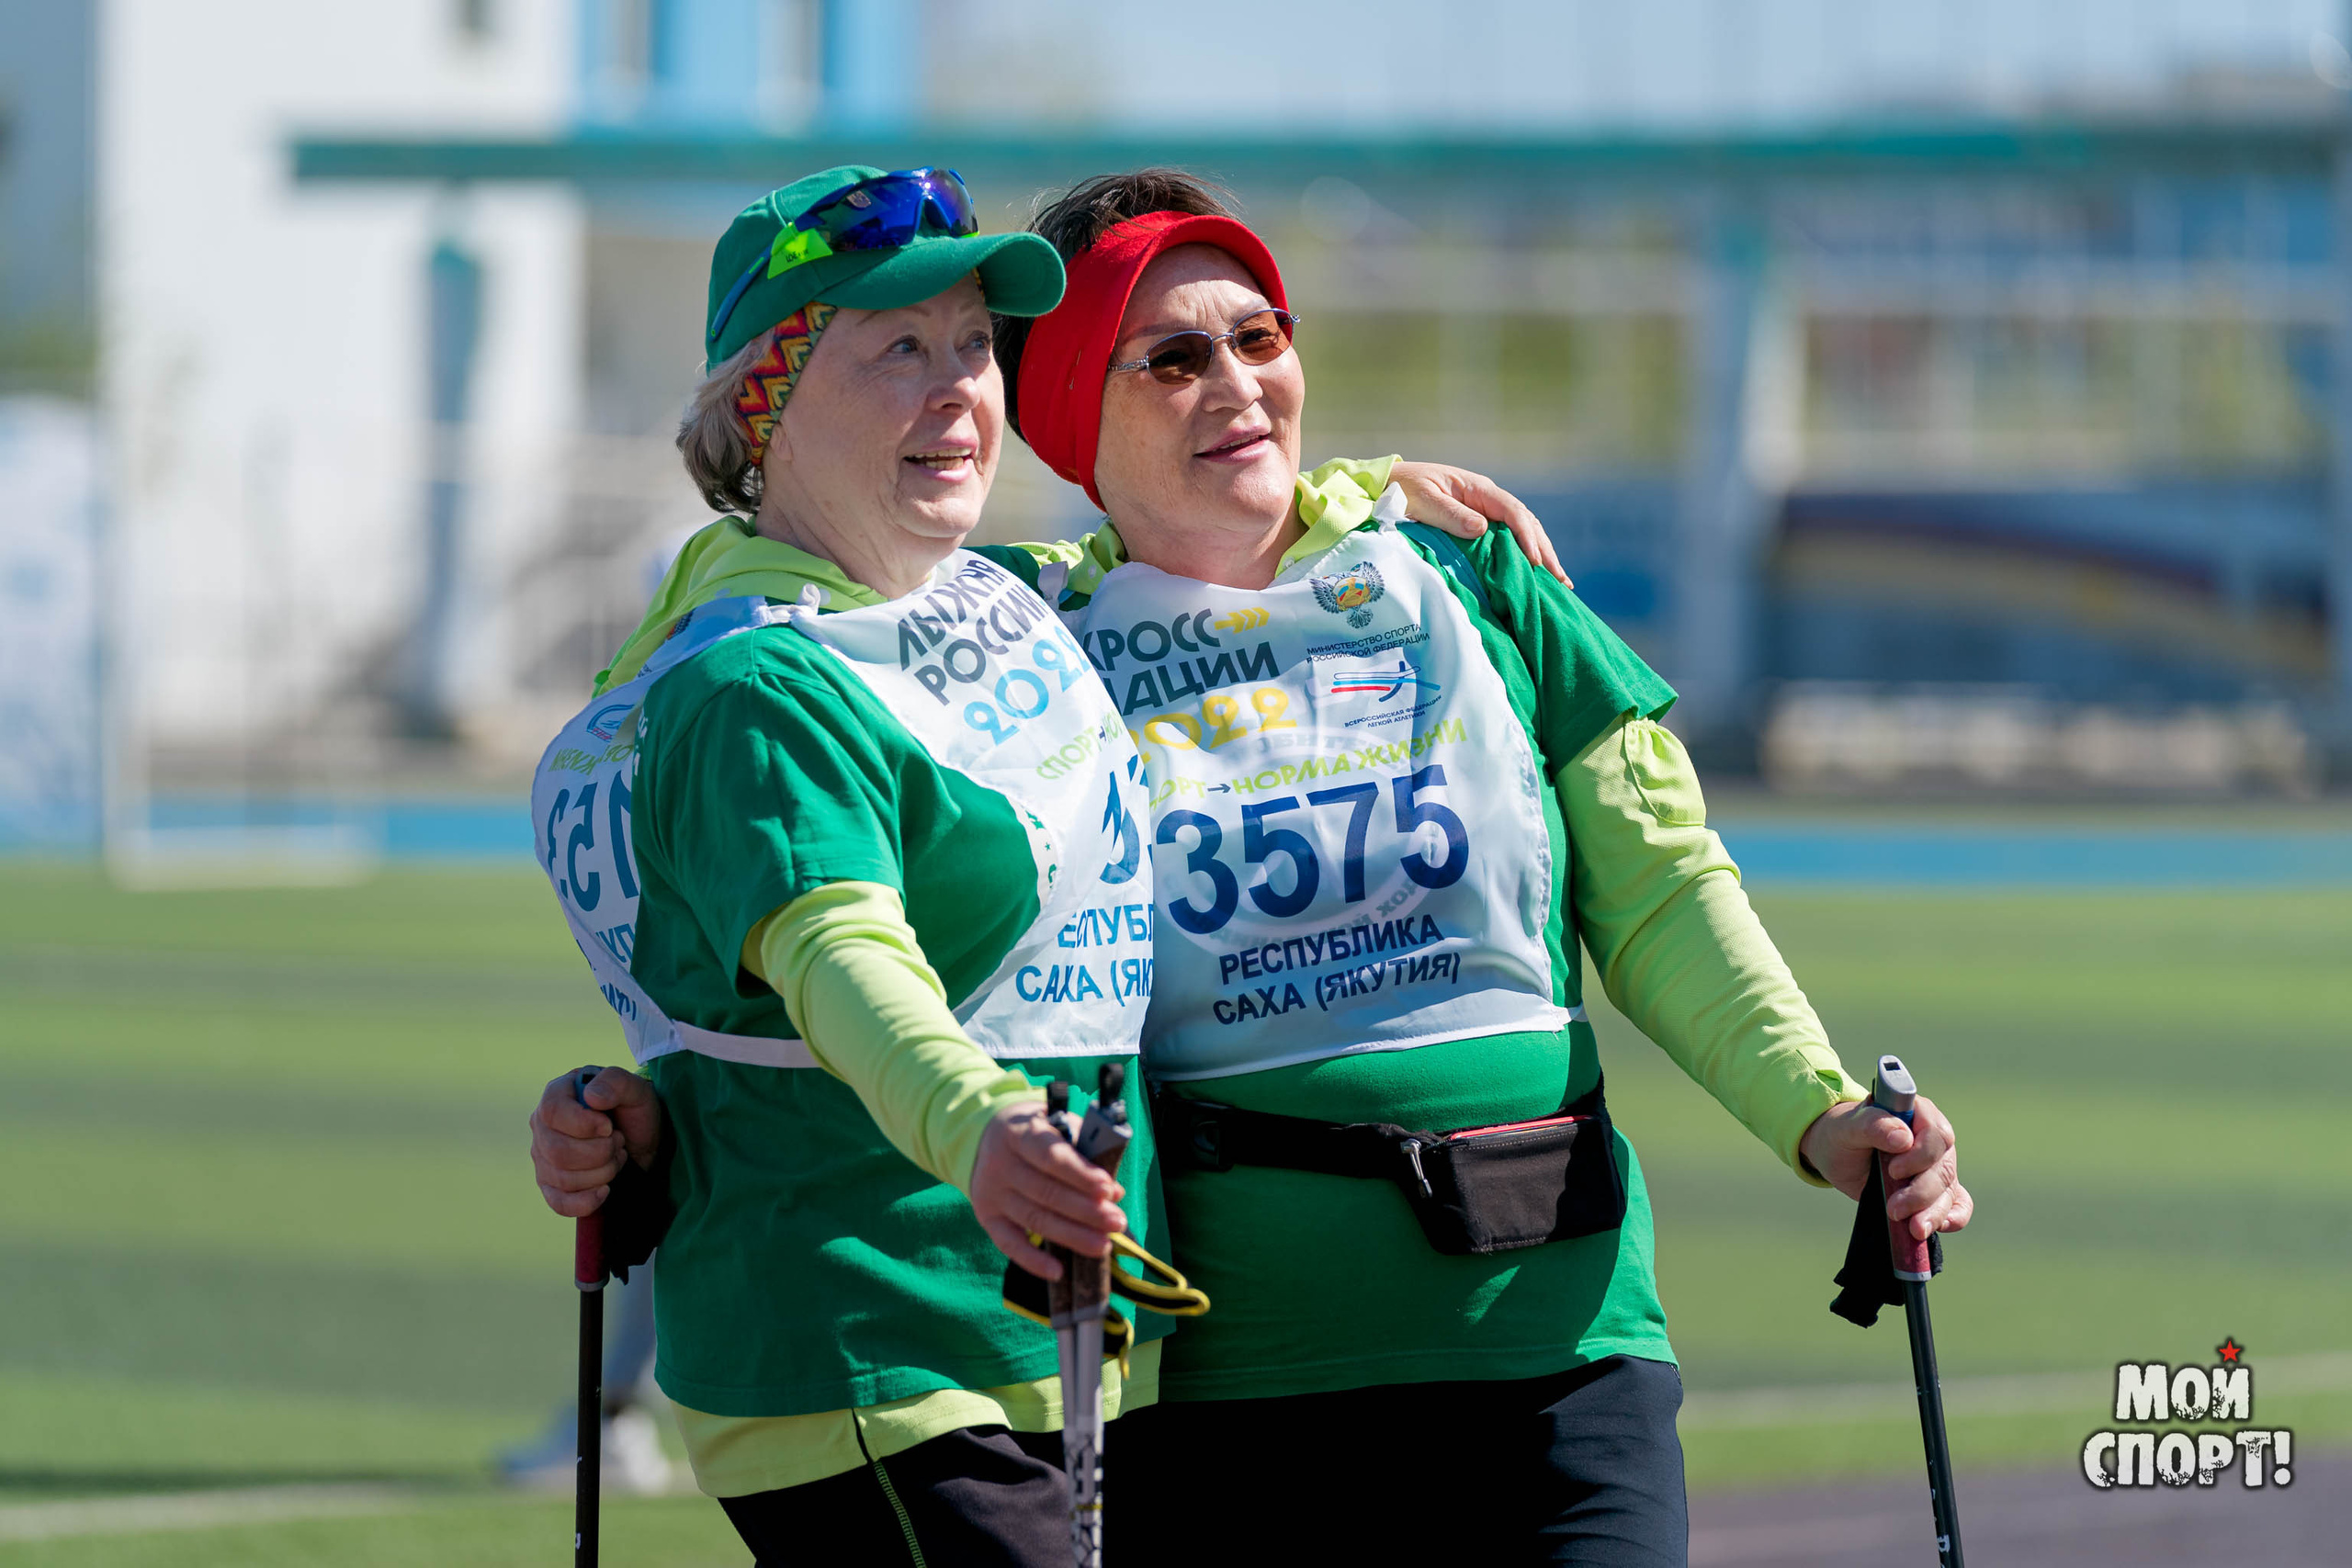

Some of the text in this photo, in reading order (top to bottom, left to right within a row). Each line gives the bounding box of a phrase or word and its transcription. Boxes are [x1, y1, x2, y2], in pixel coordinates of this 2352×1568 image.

[898, 559, 1008, 671] ЛЫЖНЯ
[913, 583, 1048, 706] РОССИИ
[1306, 624, 1421, 655] МИНИСТЕРСТВО СПОРТА
[1306, 633, 1430, 663] РОССИЙСКОЙ ФЕДЕРАЦИИ
[963, 626, 1091, 746] 2022
[1102, 641, 1281, 716] АЦИИ
[1344, 709, 1404, 728] ВСЕРОССИЙСКАЯ
[1367, 710, 1425, 728] ЛЕГКОЙ АТЛЕТИКИ
[1232, 753, 1351, 795] НОРМА
[1357, 717, 1467, 770] ЖИЗНИ
[1156, 763, 1470, 934] 3575
[1016, 964, 1103, 1003] САХА
[1219, 914, 1445, 985] РЕСПУБЛИКА
[1213, 953, 1462, 1025] САХА (ЯКУТИЯ)
